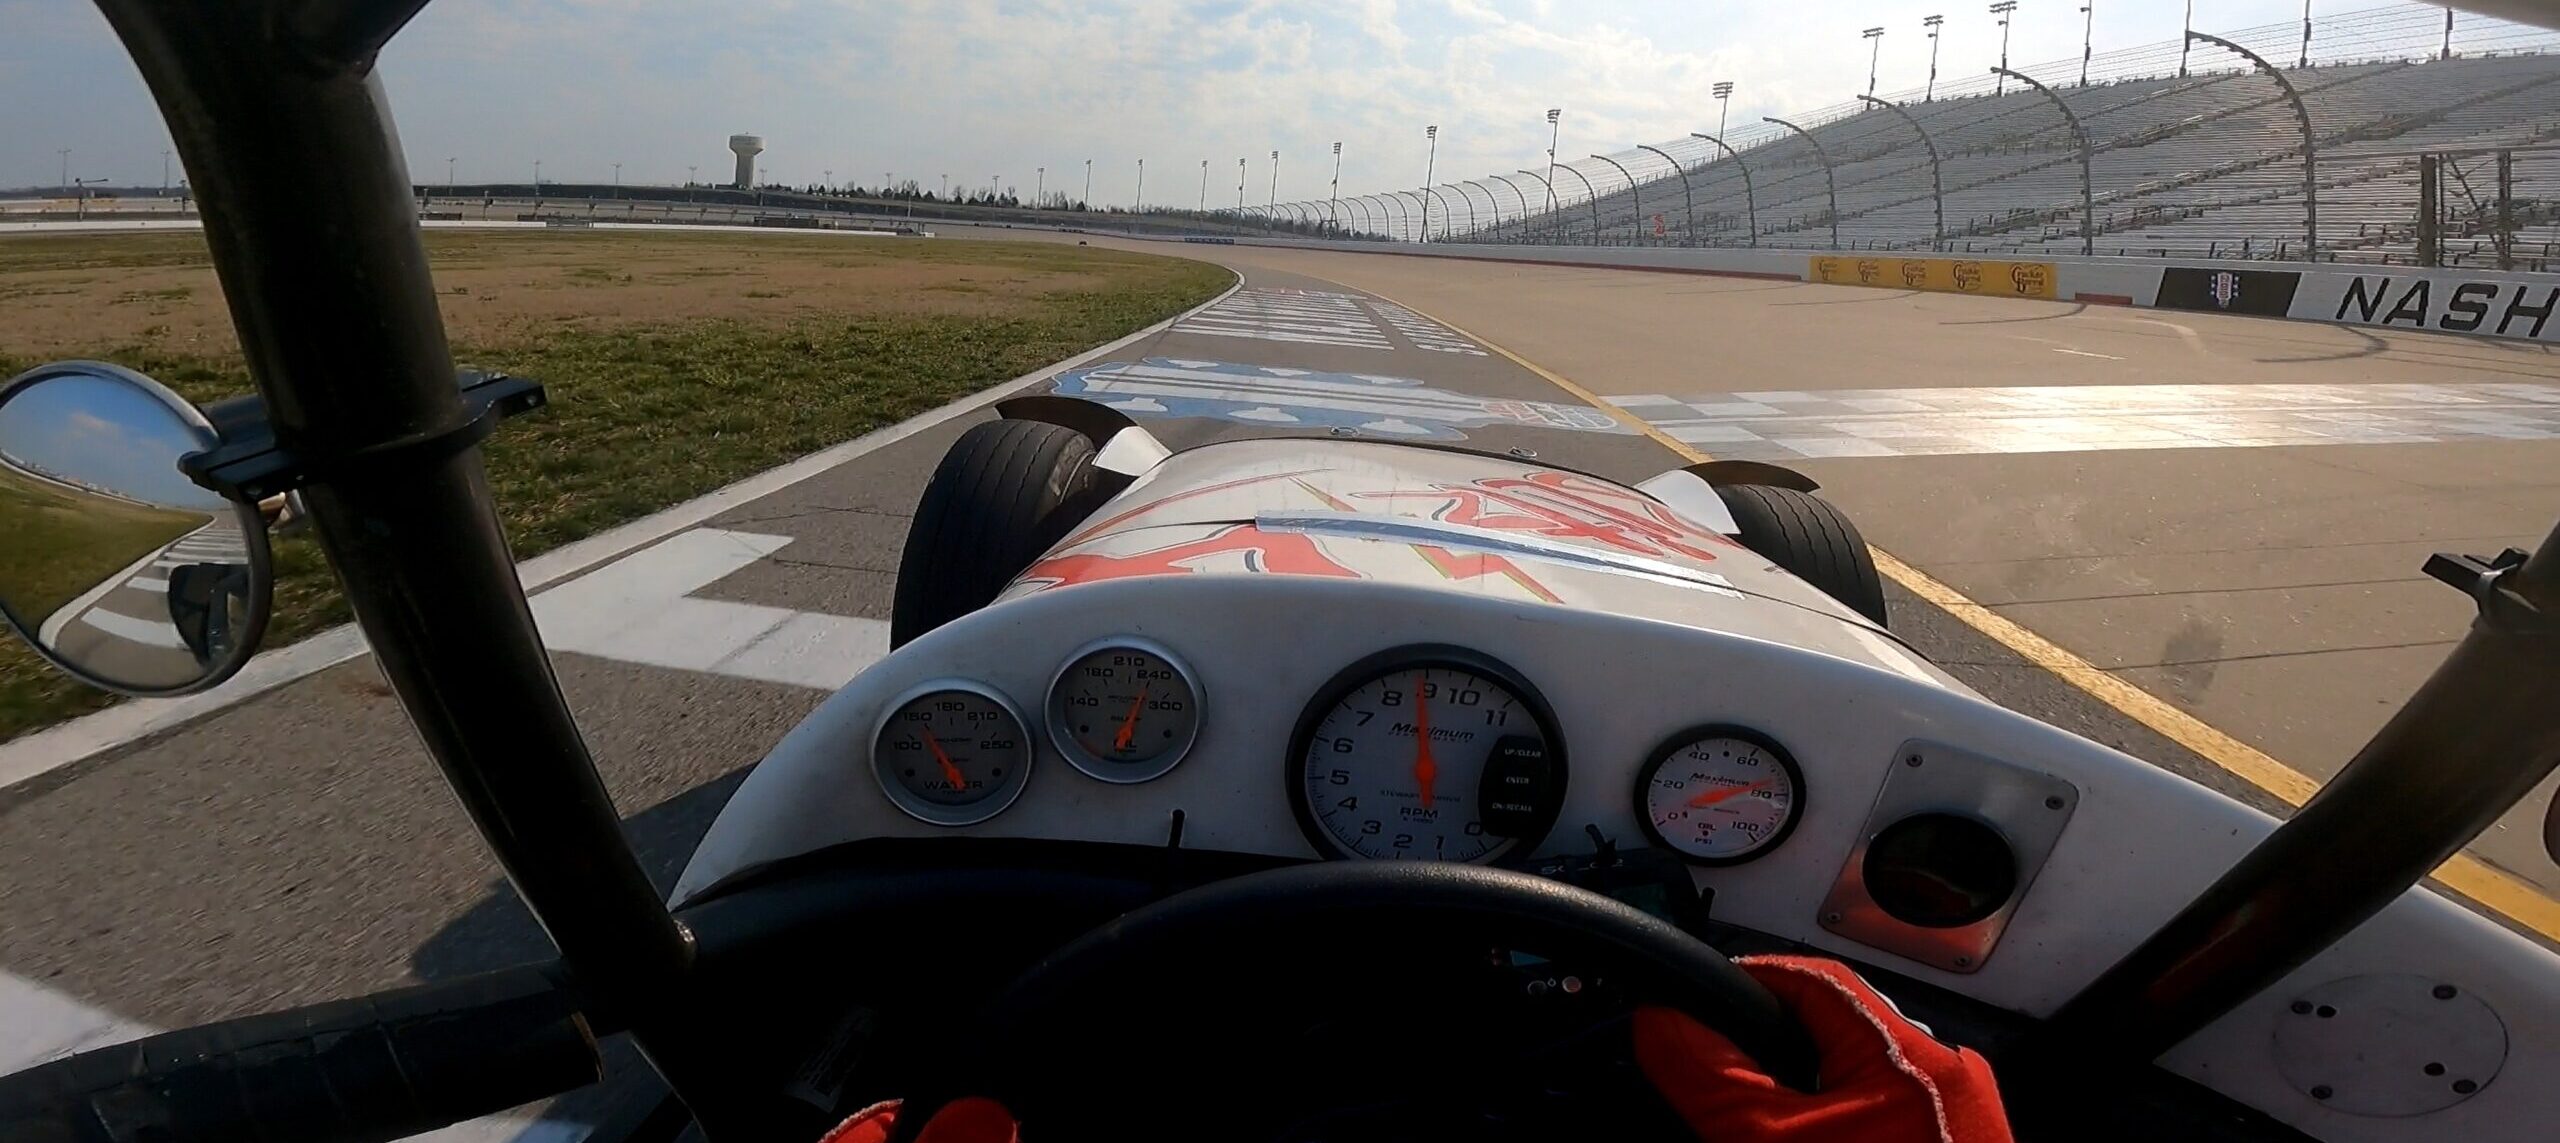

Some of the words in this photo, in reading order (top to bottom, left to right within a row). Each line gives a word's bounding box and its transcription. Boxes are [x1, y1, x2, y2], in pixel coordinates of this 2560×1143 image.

[2335, 276, 2560, 339] NASH
[1114, 656, 1145, 666] 210
[1084, 667, 1114, 677] 180
[1137, 669, 1171, 680] 240
[1422, 682, 1437, 699] 9
[1070, 696, 1099, 706] 140
[1381, 690, 1402, 706] 8
[1449, 687, 1480, 707] 10
[935, 702, 965, 712] 180
[1148, 701, 1183, 711] 300
[903, 712, 932, 721] 150
[967, 711, 998, 721] 210
[1356, 710, 1374, 727] 7
[1485, 709, 1507, 727] 11
[1390, 721, 1475, 741] Maimum
[893, 741, 922, 750] 100
[980, 740, 1014, 750] 250
[1333, 737, 1354, 754] 6
[1688, 751, 1710, 762] 40
[1736, 756, 1760, 767] 60
[1330, 769, 1350, 786] 5
[1663, 779, 1685, 790] 20
[1751, 789, 1773, 800] 80
[1338, 796, 1358, 813] 4
[1400, 807, 1439, 819] RPM
[1668, 811, 1679, 821] 0
[1361, 820, 1381, 836] 3
[1464, 820, 1485, 837] 0
[1732, 820, 1760, 832] 100
[1393, 834, 1413, 849] 2
[1436, 835, 1445, 850] 1
[1694, 837, 1713, 846] PSI
